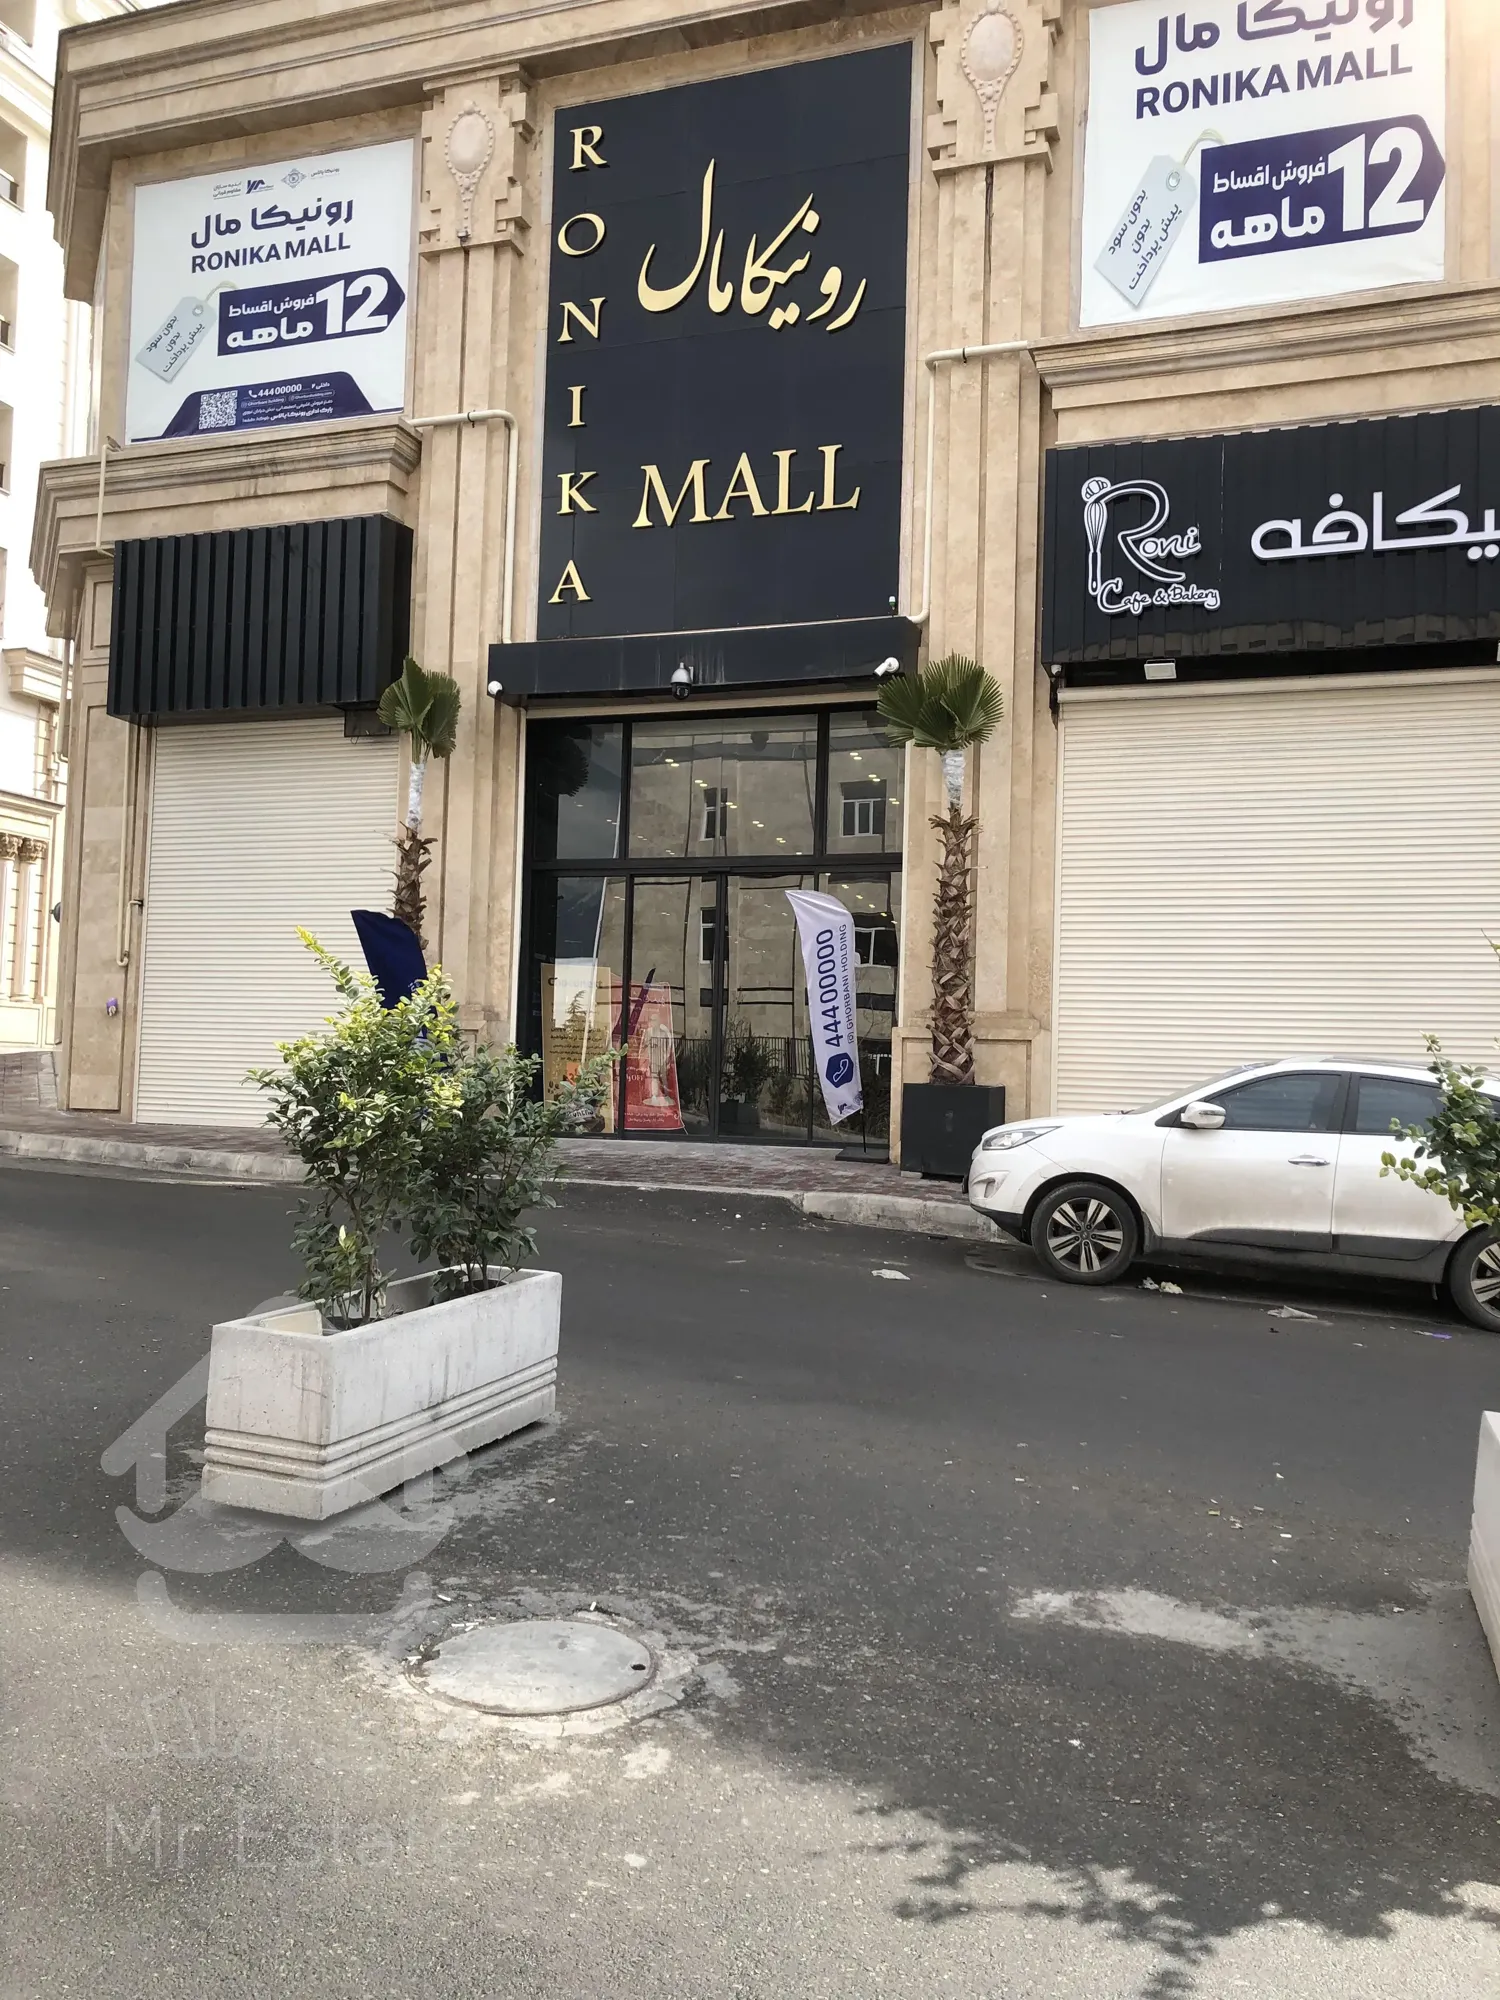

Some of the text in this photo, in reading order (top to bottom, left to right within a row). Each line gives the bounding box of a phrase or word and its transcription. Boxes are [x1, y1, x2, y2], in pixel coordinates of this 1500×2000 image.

[1135, 12, 1220, 76] مال
[1136, 43, 1413, 120] RONIKA MALL
[1213, 157, 1325, 193] فروش اقساط
[1328, 126, 1424, 232] 12
[191, 198, 353, 249] رونیکا مال
[637, 158, 867, 331] رونیکا مال
[1108, 189, 1148, 255] بدون سود
[1128, 203, 1183, 290] پیش پرداخت
[1131, 218, 1153, 254] بدون
[1210, 196, 1325, 249] ماهه
[192, 232, 350, 273] RONIKA MALL
[226, 317, 314, 348] ماهه
[229, 294, 314, 317] فروش اقساط
[316, 274, 388, 335] 12
[146, 315, 179, 352] بدون سود
[162, 323, 205, 373] پیش پرداخت
[165, 331, 182, 352] بدون
[547, 125, 607, 604] RONIKA
[632, 444, 860, 528] MALL
[1090, 479, 1201, 584] Roni
[1097, 577, 1220, 615] Cafe & Bakery
[816, 928, 844, 1048] 44400000
